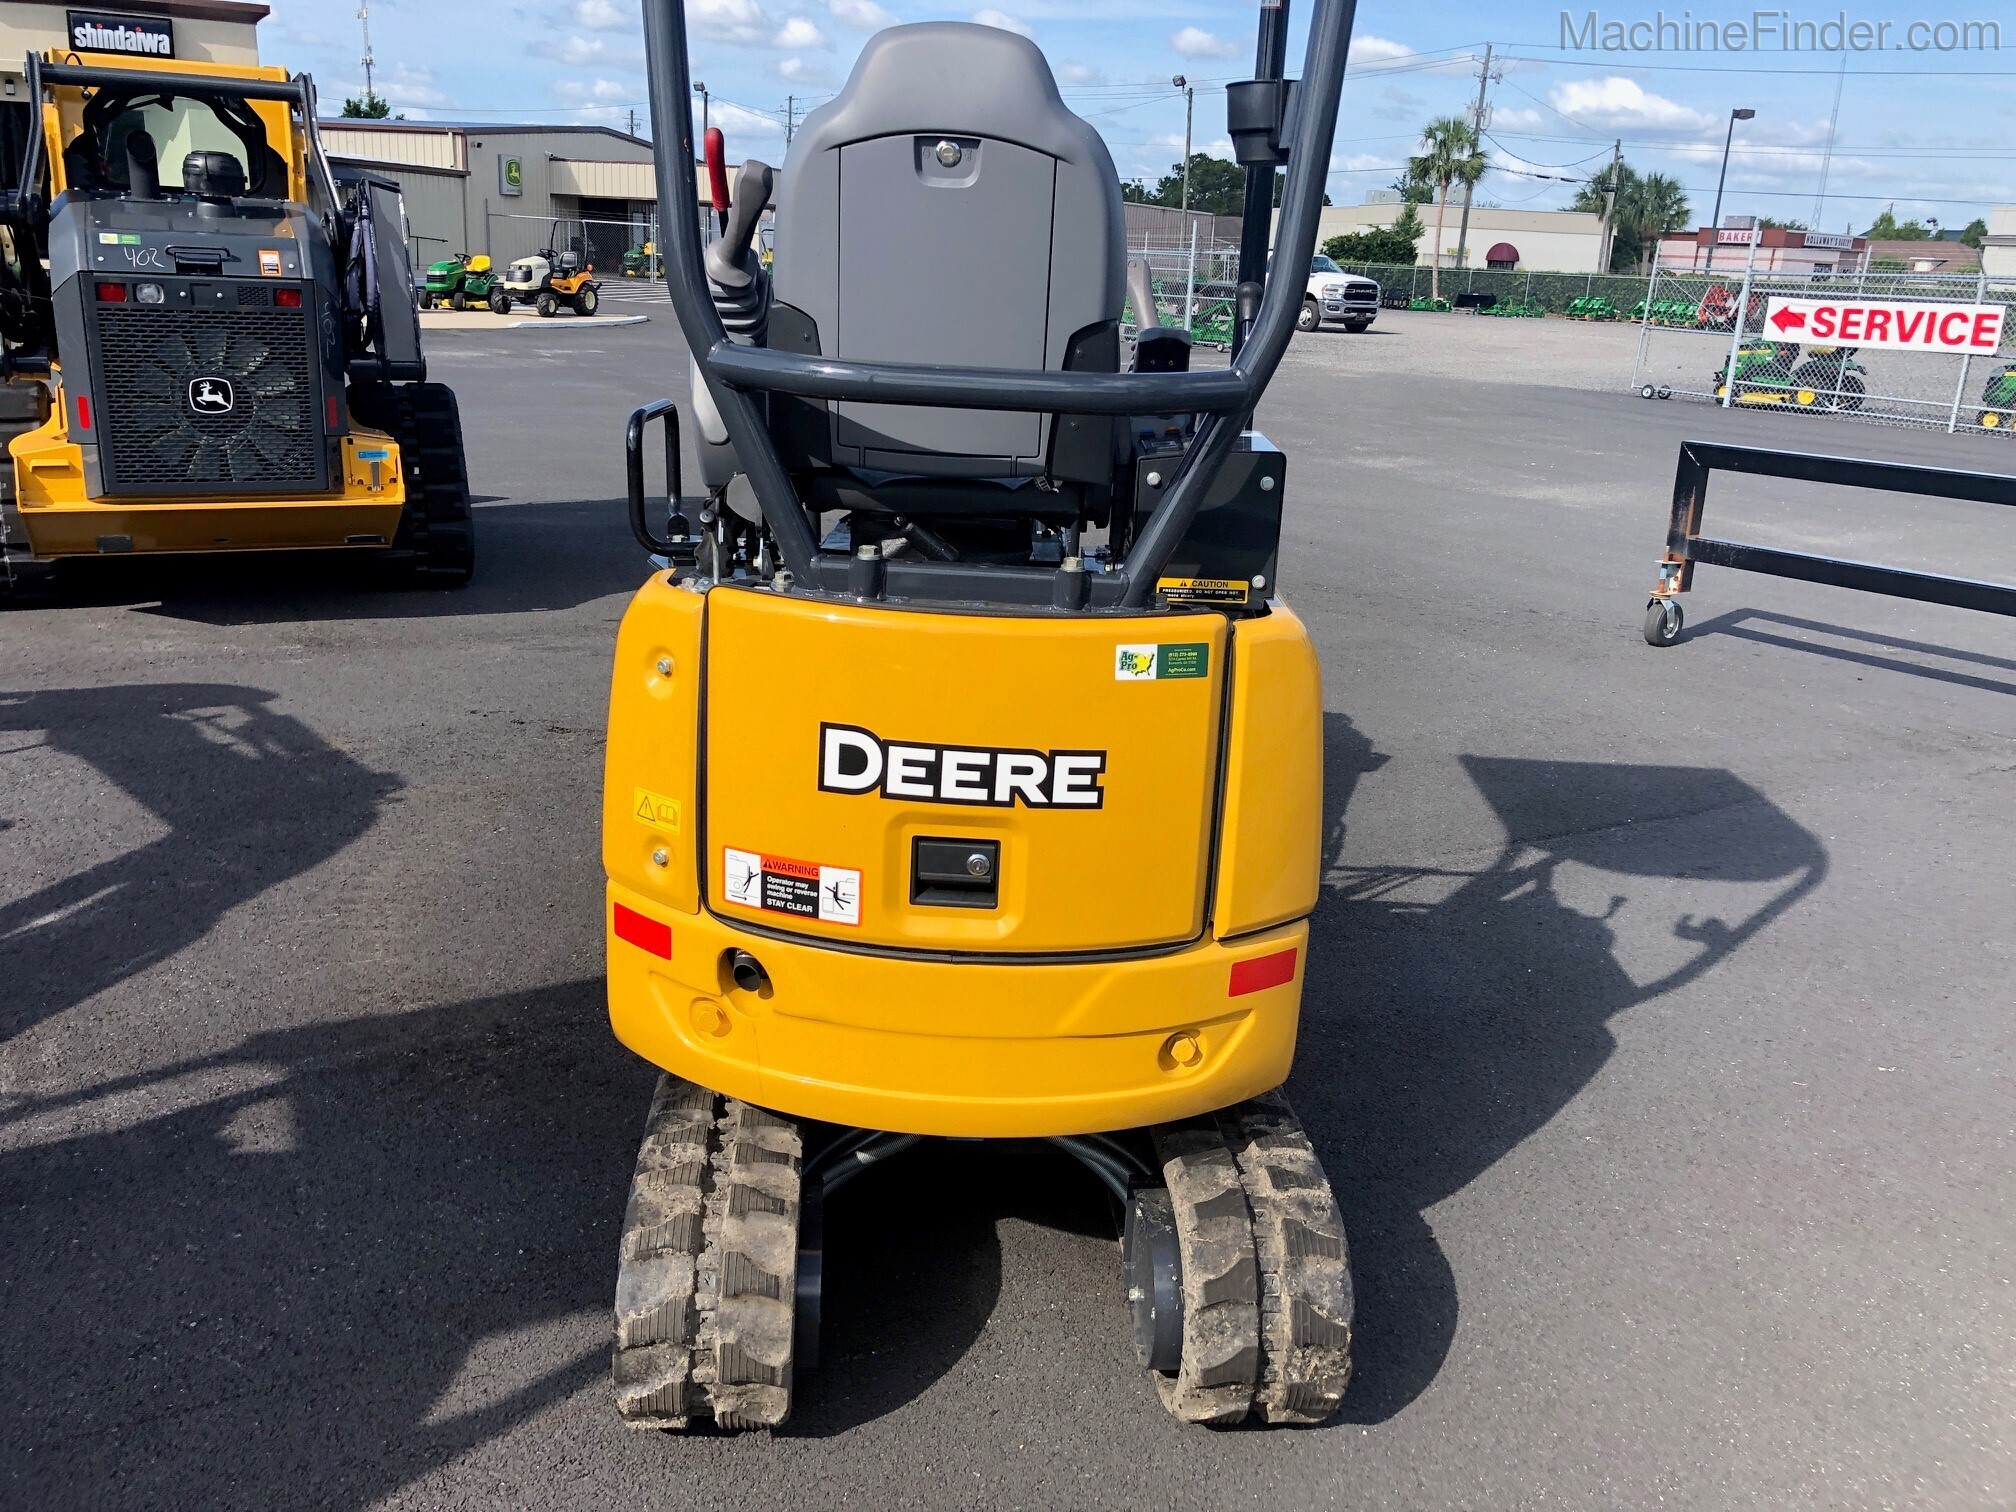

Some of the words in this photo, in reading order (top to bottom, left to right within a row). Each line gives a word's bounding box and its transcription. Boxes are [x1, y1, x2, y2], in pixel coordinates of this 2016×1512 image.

[74, 22, 171, 54] shindaiwa
[1718, 231, 1760, 243] BAKER
[123, 246, 165, 268] 402
[1811, 306, 1999, 348] SERVICE
[1191, 580, 1229, 588] CAUTION
[1120, 650, 1138, 663] Ag-
[1120, 661, 1138, 670] Pro
[821, 725, 1104, 806] DEERE
[773, 860, 819, 877] WARNING
[766, 875, 794, 887] Operator
[795, 880, 809, 890] may
[766, 883, 786, 894] swing
[794, 888, 818, 898] reverse
[766, 890, 793, 900] machine
[766, 898, 785, 908] STAY
[786, 901, 813, 913] CLEAR
